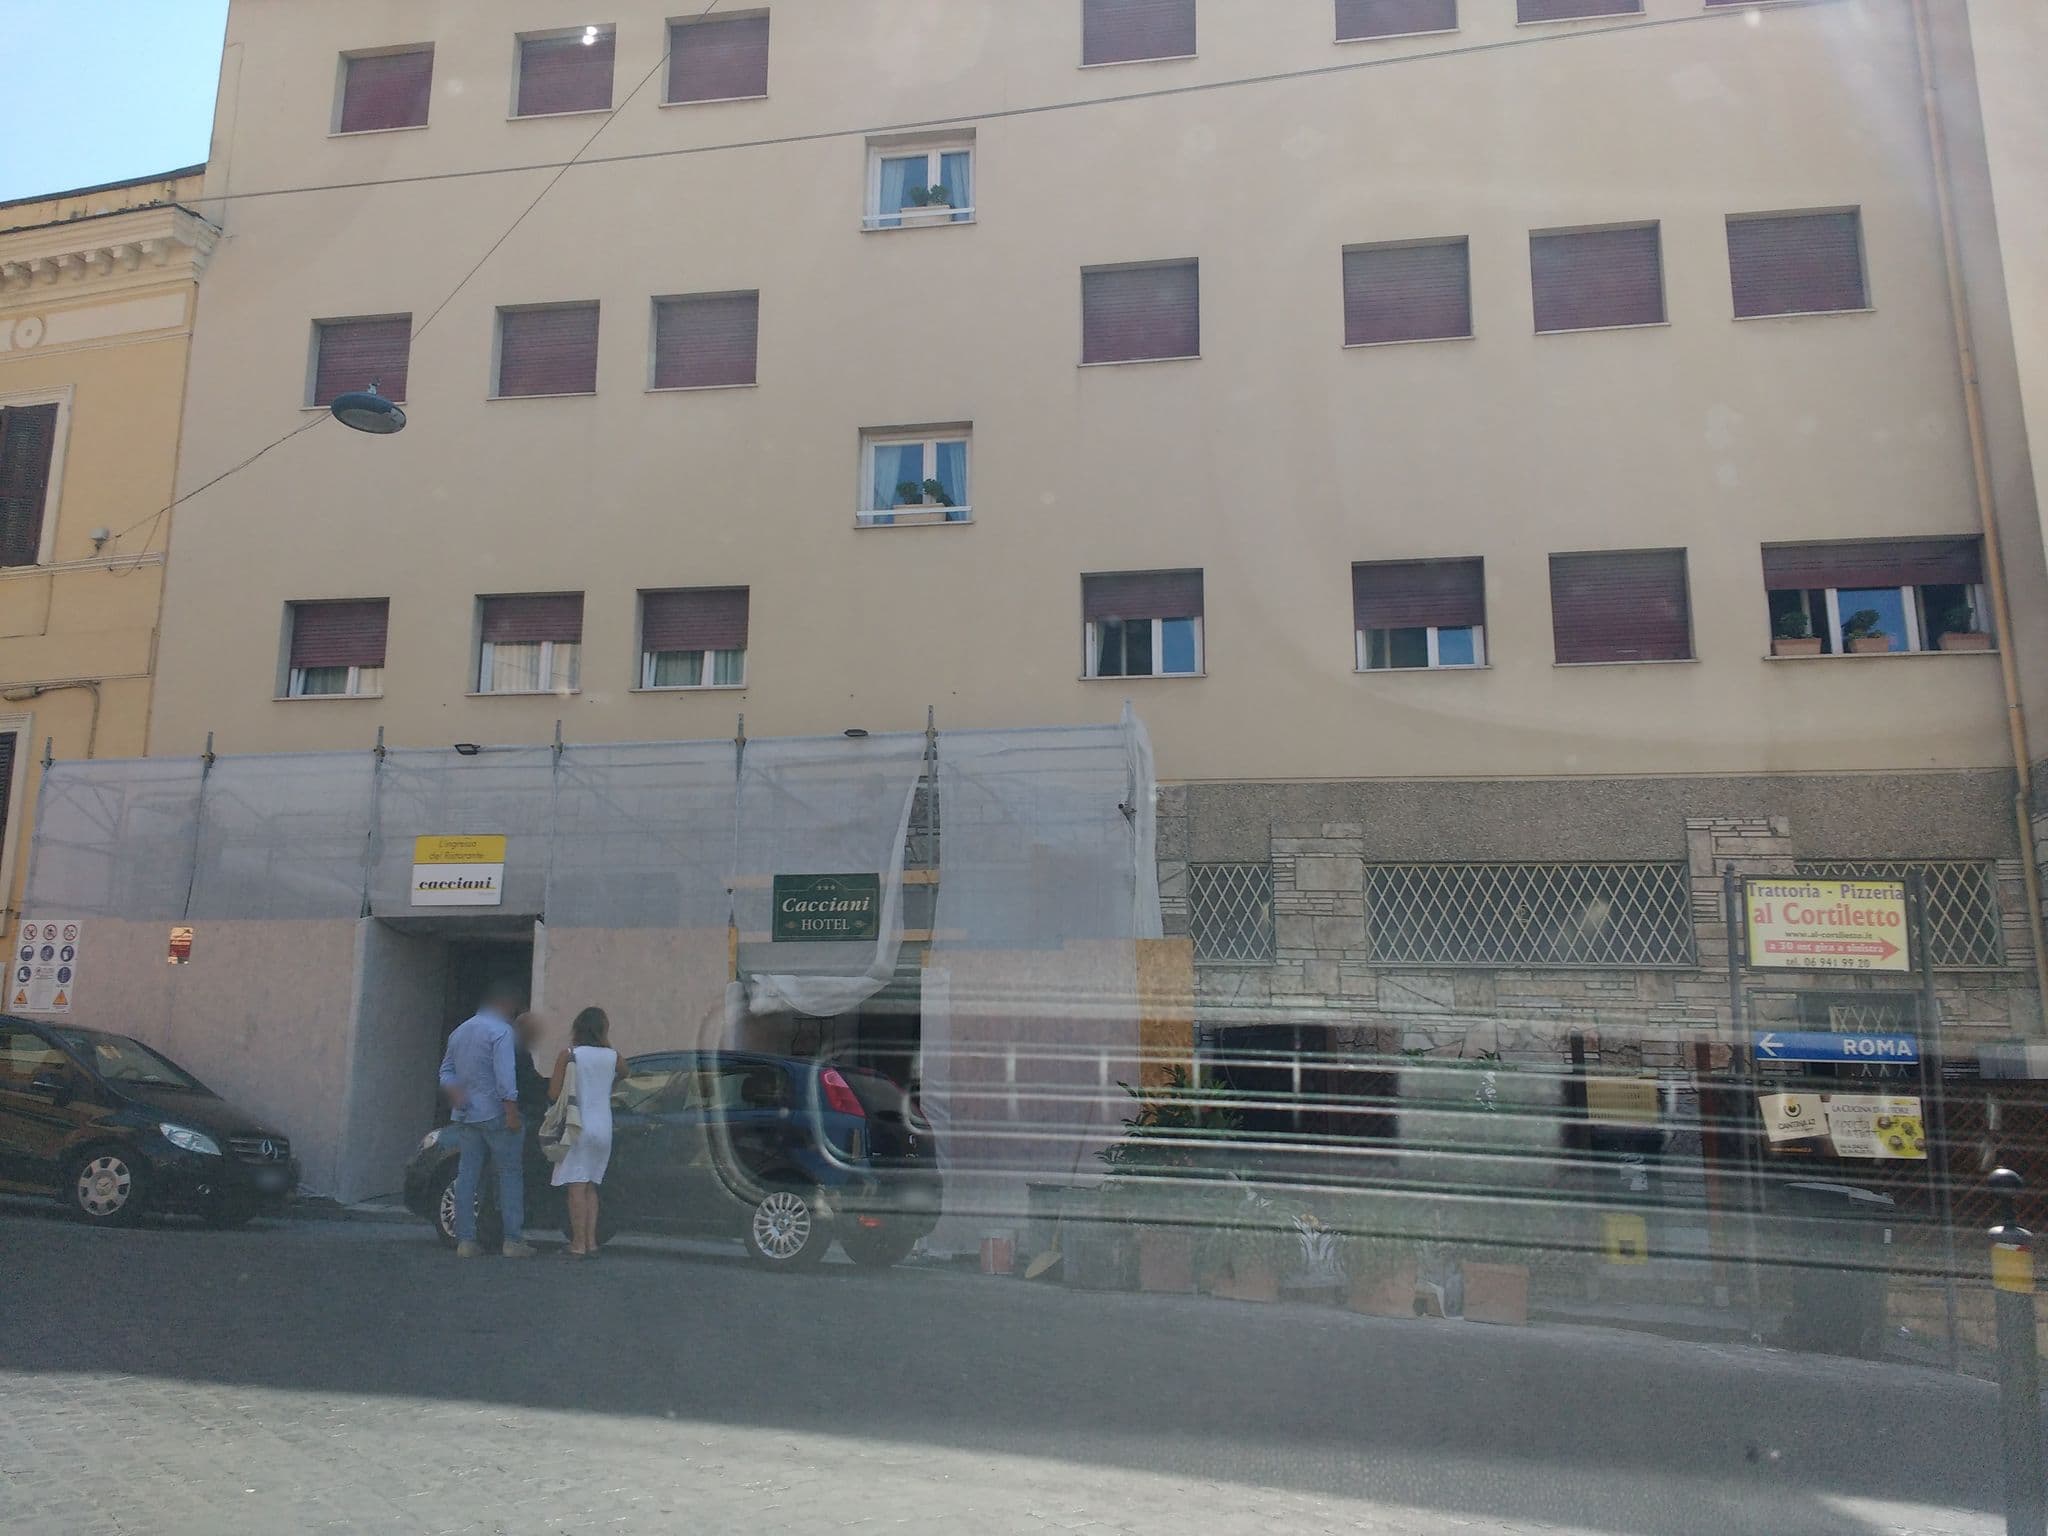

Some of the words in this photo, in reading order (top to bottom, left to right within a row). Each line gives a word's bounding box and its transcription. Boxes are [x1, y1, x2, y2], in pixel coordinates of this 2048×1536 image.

[419, 877, 492, 890] cacciani
[1748, 882, 1821, 899] Trattoria
[1840, 884, 1905, 900] Pizzeria
[782, 896, 870, 913] Cacciani
[1754, 903, 1773, 924] al
[1783, 902, 1901, 927] Cortiletto
[801, 918, 850, 931] HOTEL
[1804, 957, 1817, 967] 06
[1820, 958, 1838, 967] 941
[1842, 958, 1854, 968] 99
[1858, 959, 1871, 968] 20
[1843, 1038, 1913, 1057] ROMA
